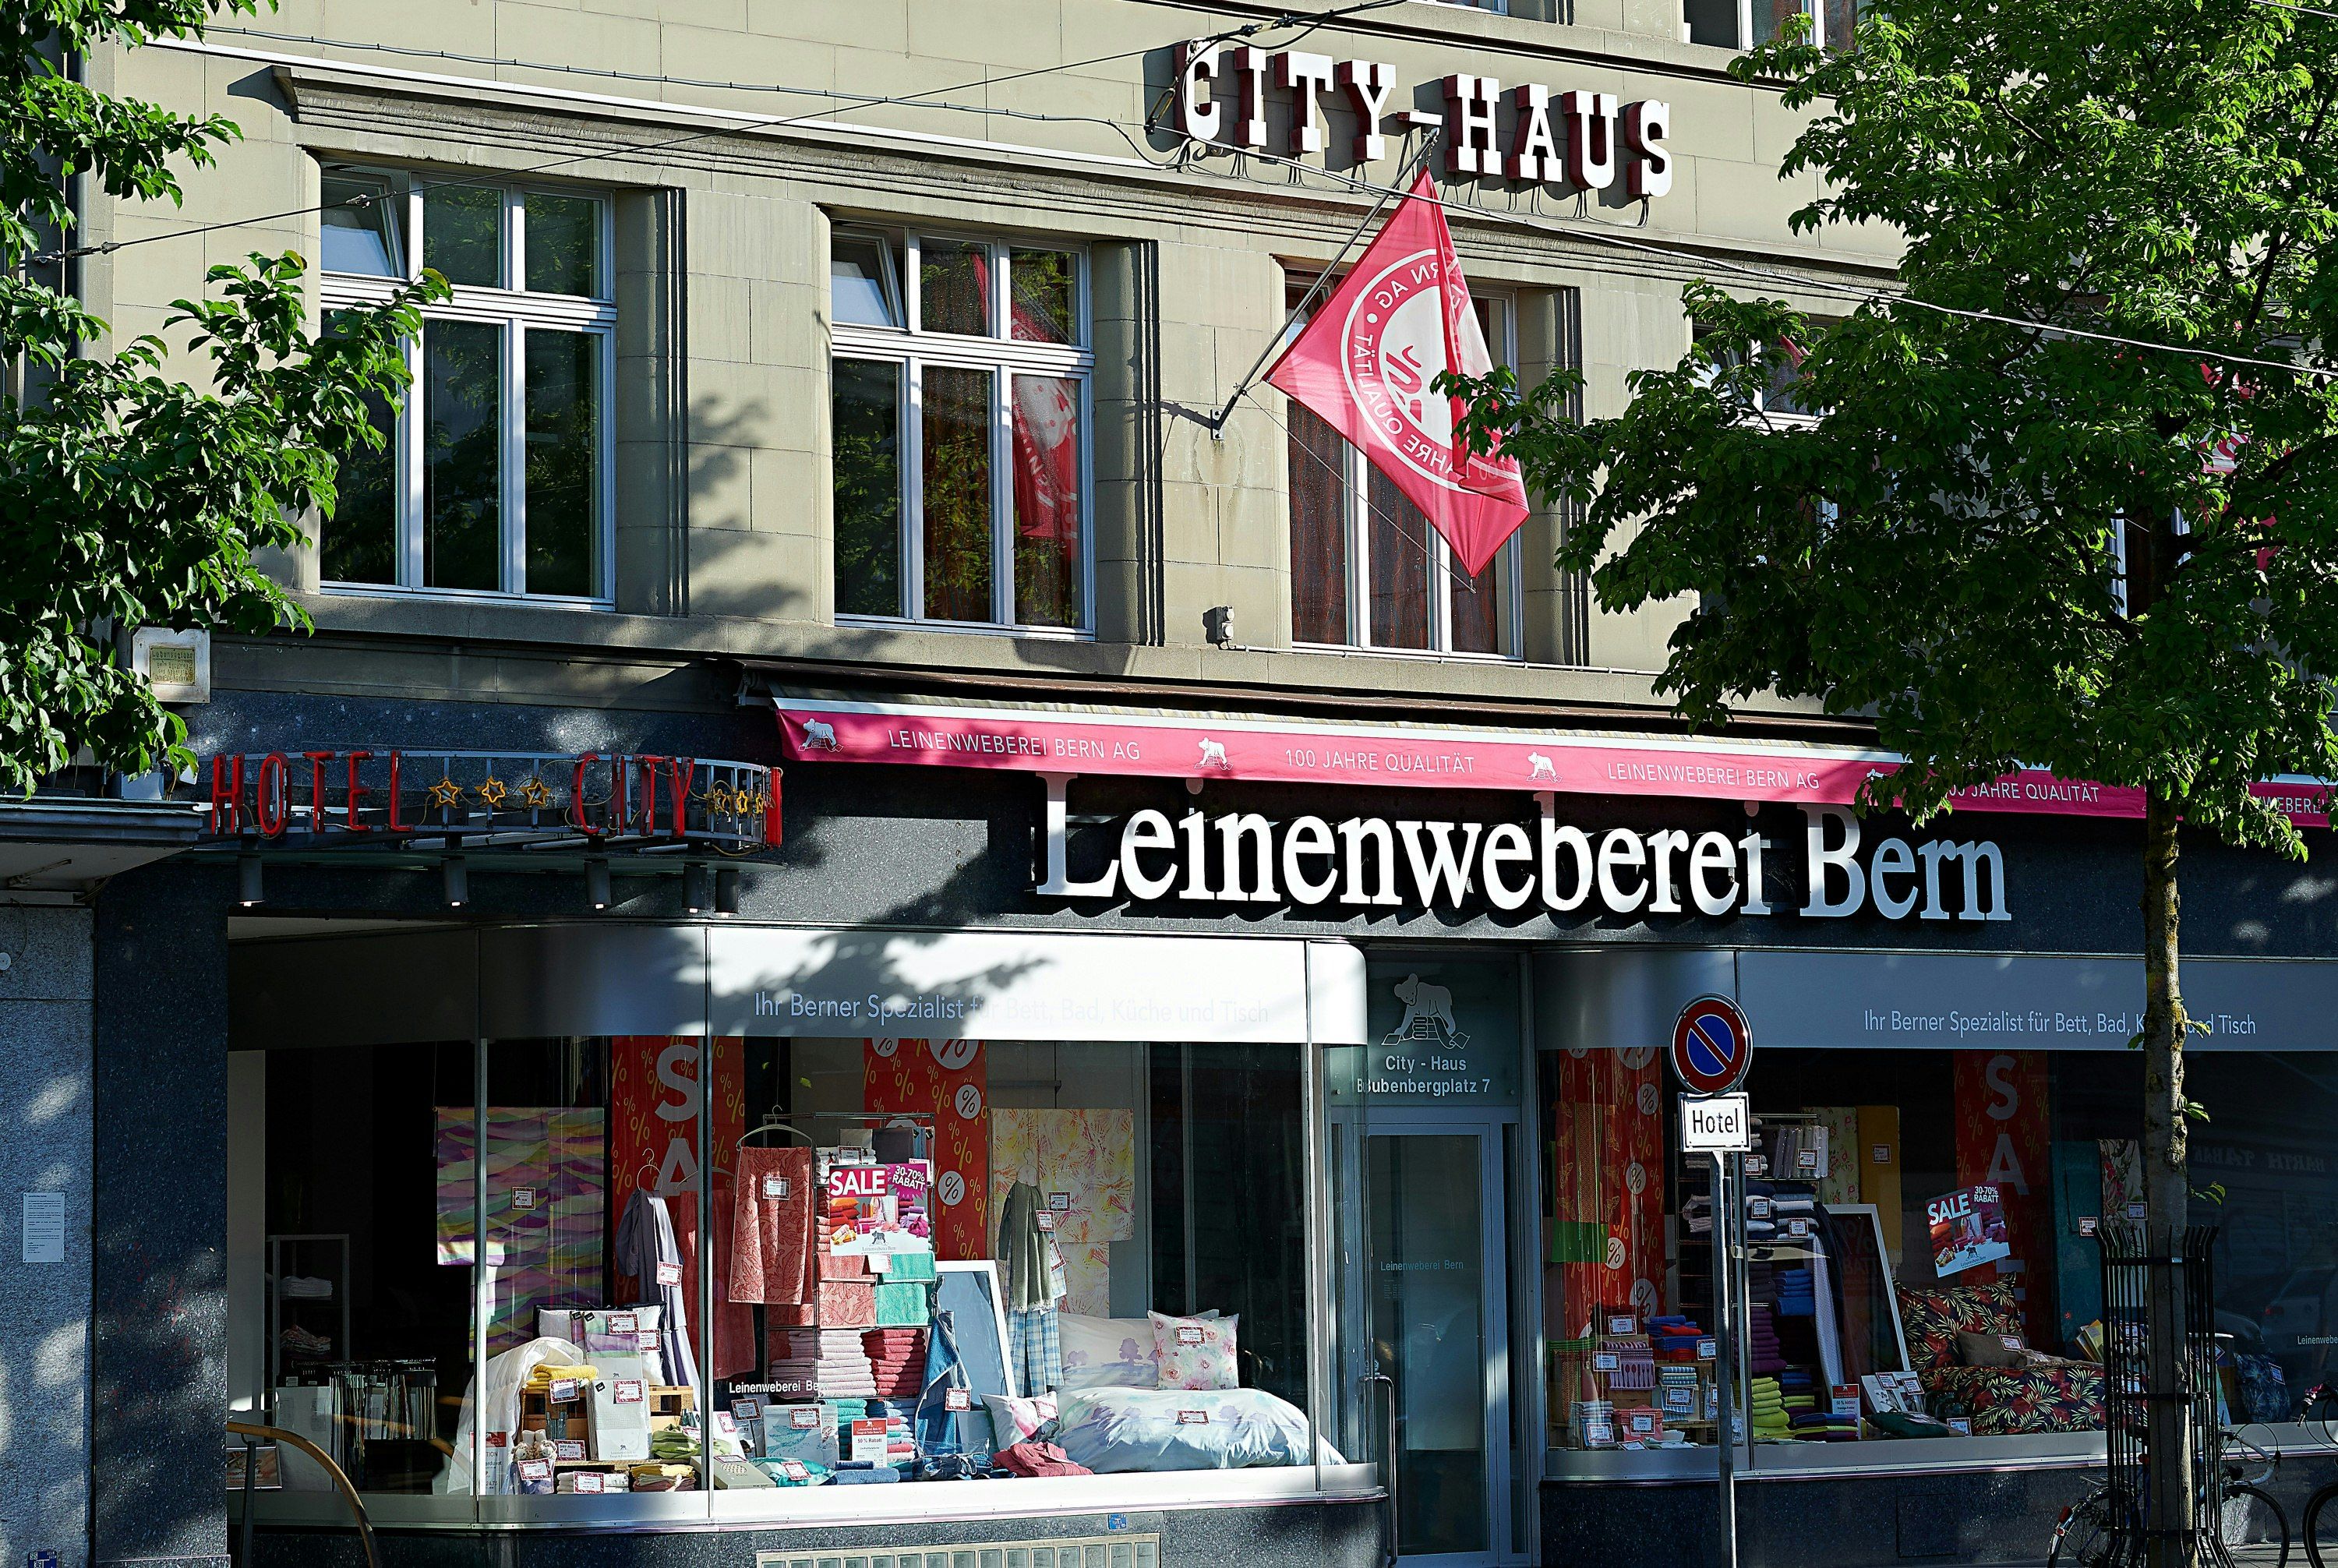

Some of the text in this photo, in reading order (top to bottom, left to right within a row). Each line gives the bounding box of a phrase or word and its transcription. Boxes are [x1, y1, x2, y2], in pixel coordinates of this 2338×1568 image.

[1175, 37, 1672, 198] CITY-HAUS
[888, 728, 1142, 761] LEINENWEBEREI BERN AG
[1284, 748, 1474, 774] 100 JAHRE QUALITÄT
[1607, 761, 1820, 789] LEINENWEBEREI BERN AG
[211, 750, 415, 837] HOTEL
[570, 750, 695, 839] CITY
[1971, 782, 2021, 799] JAHRE
[2025, 783, 2100, 803] QUALITÄT
[1036, 772, 2013, 921] Leinenweberei Bern
[754, 991, 782, 1016] Ihr
[789, 992, 860, 1019] Berner
[867, 993, 964, 1026] Spezialist
[1864, 1010, 1886, 1031] Ihr
[1891, 1011, 1945, 1032] Berner
[1949, 1011, 2024, 1039] Spezialist
[2028, 1011, 2050, 1033] für
[2055, 1012, 2093, 1036] Bett,
[2097, 1013, 2131, 1037] Bad,
[2219, 1014, 2257, 1035] Tisch
[1385, 1054, 1415, 1074] City
[1431, 1055, 1467, 1071] Haus
[1358, 1078, 1491, 1097] Bubenbergplatz 7
[1692, 1107, 1739, 1134] Hotel
[830, 1170, 885, 1197] SALE
[892, 1174, 926, 1192] RABATT
[895, 1165, 926, 1182] 30-70%
[1973, 1194, 1999, 1203] RABATT
[1974, 1185, 1998, 1195] 30-70%
[1927, 1193, 1971, 1226] SALE
[1380, 1259, 1464, 1271] Leinenweberei Bern
[729, 1379, 801, 1393] Leinenweberei
